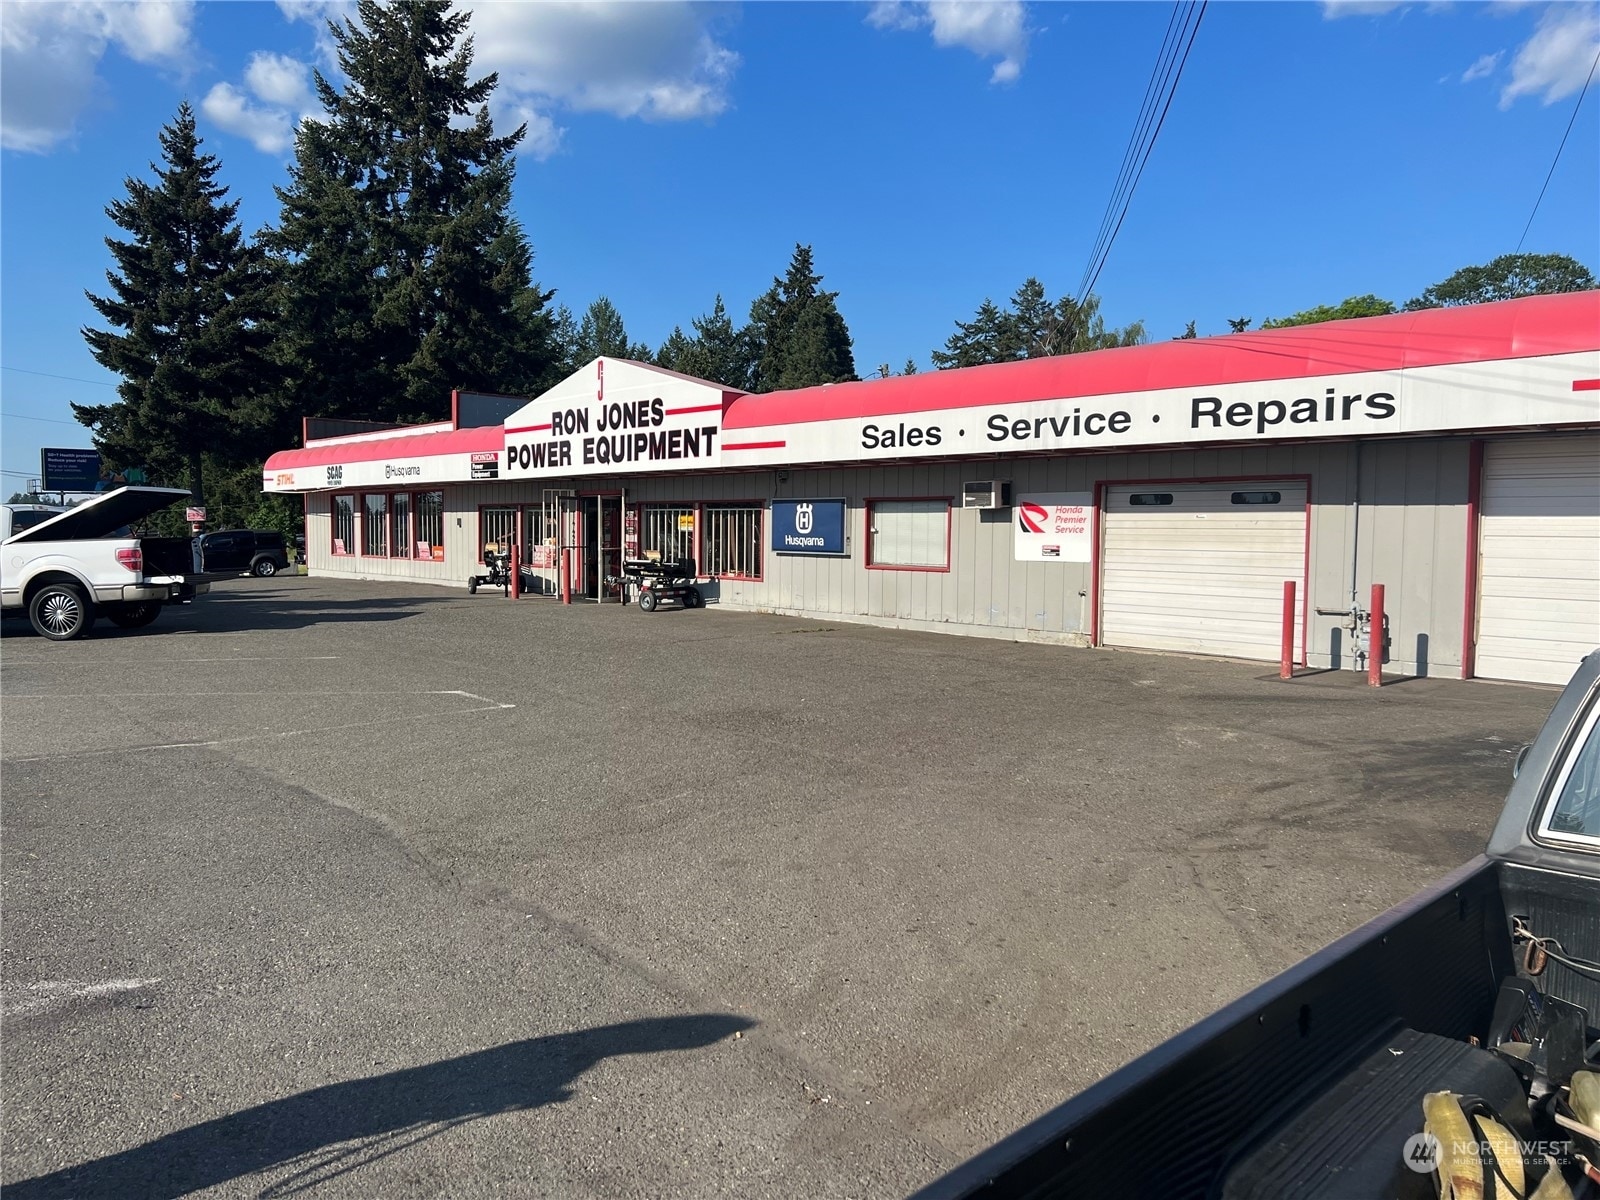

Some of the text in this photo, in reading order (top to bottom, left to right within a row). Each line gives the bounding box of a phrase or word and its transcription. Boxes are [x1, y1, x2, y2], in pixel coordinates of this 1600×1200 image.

[552, 398, 664, 436] RON JONES
[861, 388, 1396, 449] Sales Service Repairs
[507, 426, 718, 470] POWER EQUIPMENT
[473, 453, 496, 461] HONDA
[326, 465, 343, 480] SCAG
[391, 465, 421, 478] Husqvarna
[276, 474, 295, 485] STIHL
[1055, 505, 1083, 514] Honda
[1055, 515, 1087, 523] Premier
[1055, 525, 1085, 534] Service
[785, 534, 825, 547] Husqvarna
